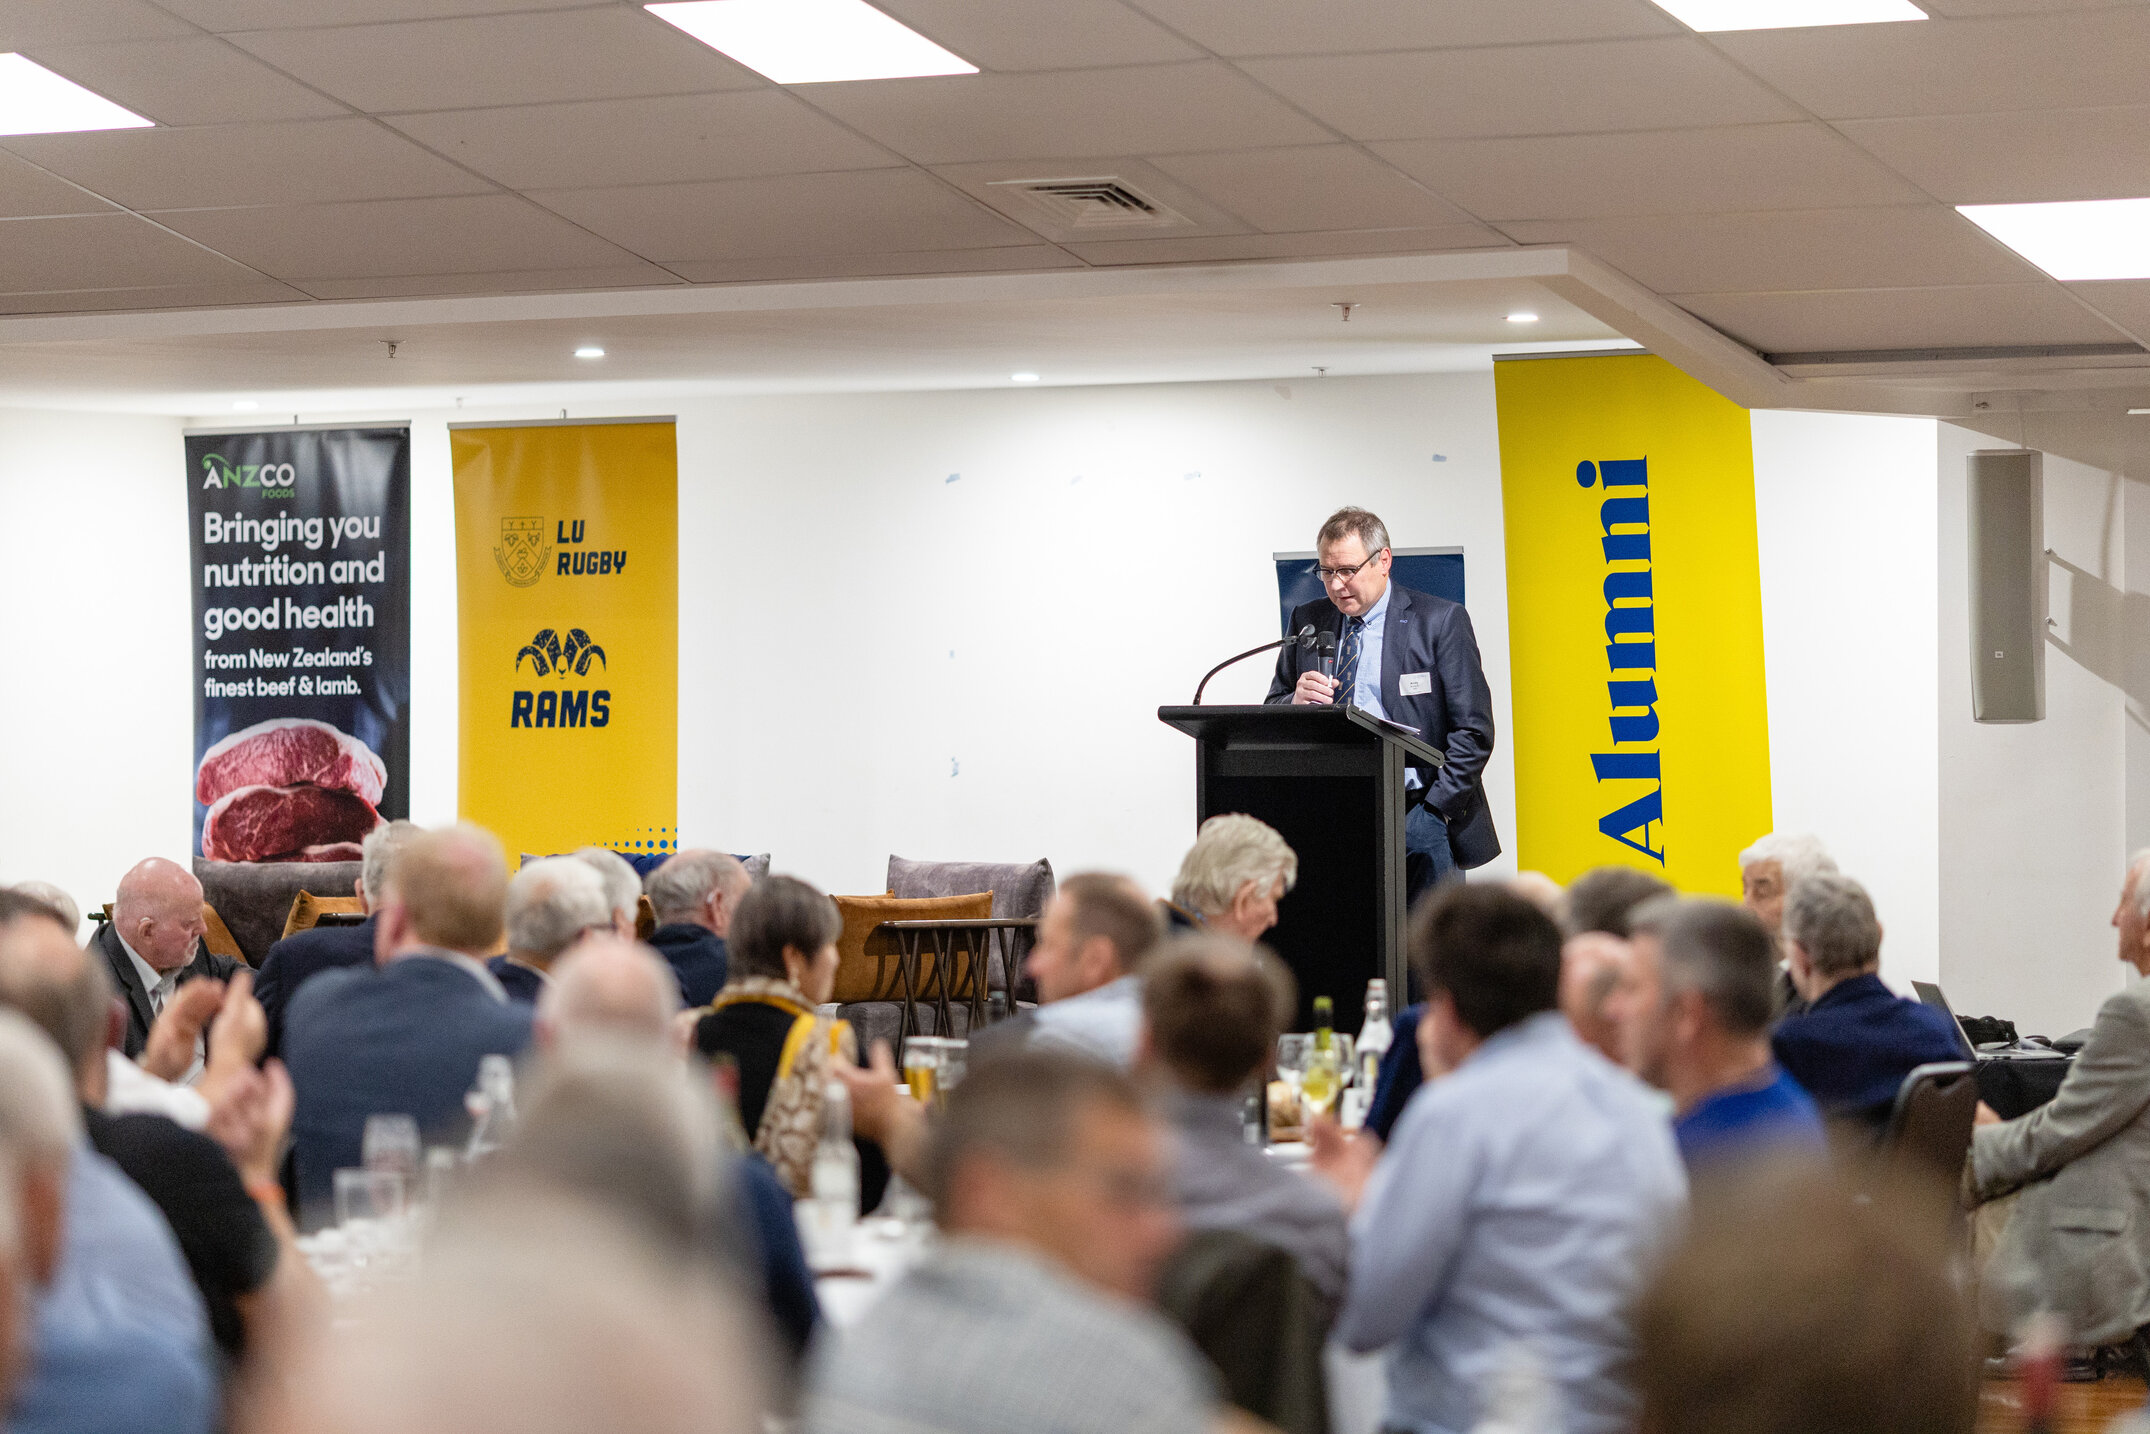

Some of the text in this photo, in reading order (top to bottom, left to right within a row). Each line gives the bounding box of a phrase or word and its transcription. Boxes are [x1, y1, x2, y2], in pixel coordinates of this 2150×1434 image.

[203, 463, 295, 489] ANZCO
[204, 510, 381, 551] Bringing you
[557, 520, 585, 543] LU
[204, 550, 385, 588] nutrition and
[557, 551, 627, 575] RUGBY
[204, 595, 374, 641] good health
[204, 646, 373, 669] from New Zealand's
[1575, 454, 1666, 869] Alumni
[204, 674, 362, 697] finest beef & lamb.
[511, 690, 611, 728] RAMS
